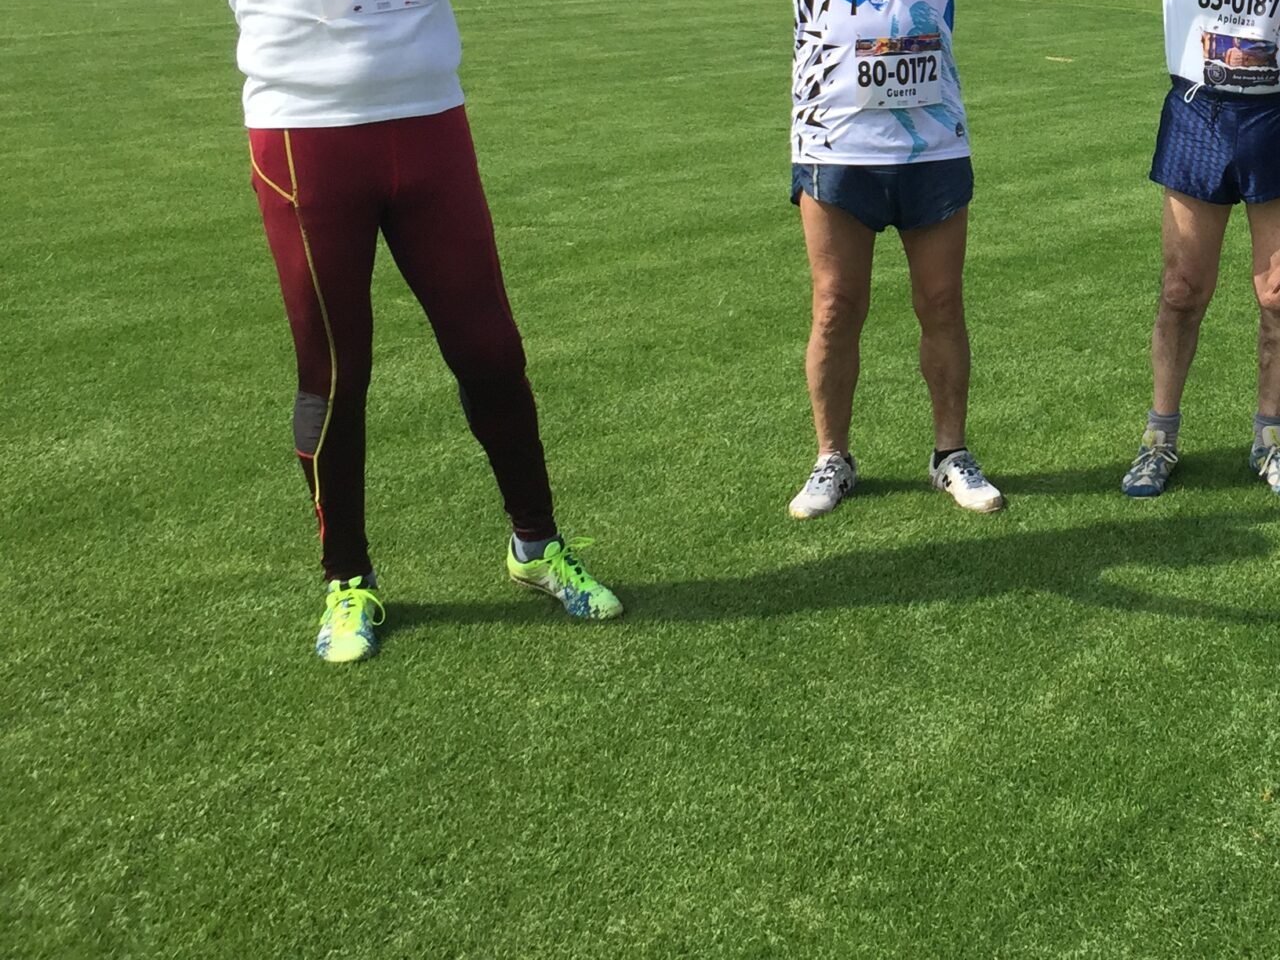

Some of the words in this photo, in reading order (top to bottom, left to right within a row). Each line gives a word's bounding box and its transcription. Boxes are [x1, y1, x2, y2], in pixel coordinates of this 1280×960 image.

[1217, 14, 1256, 27] Apiolaza
[857, 55, 937, 87] 80-0172
[886, 87, 917, 98] Guerra
